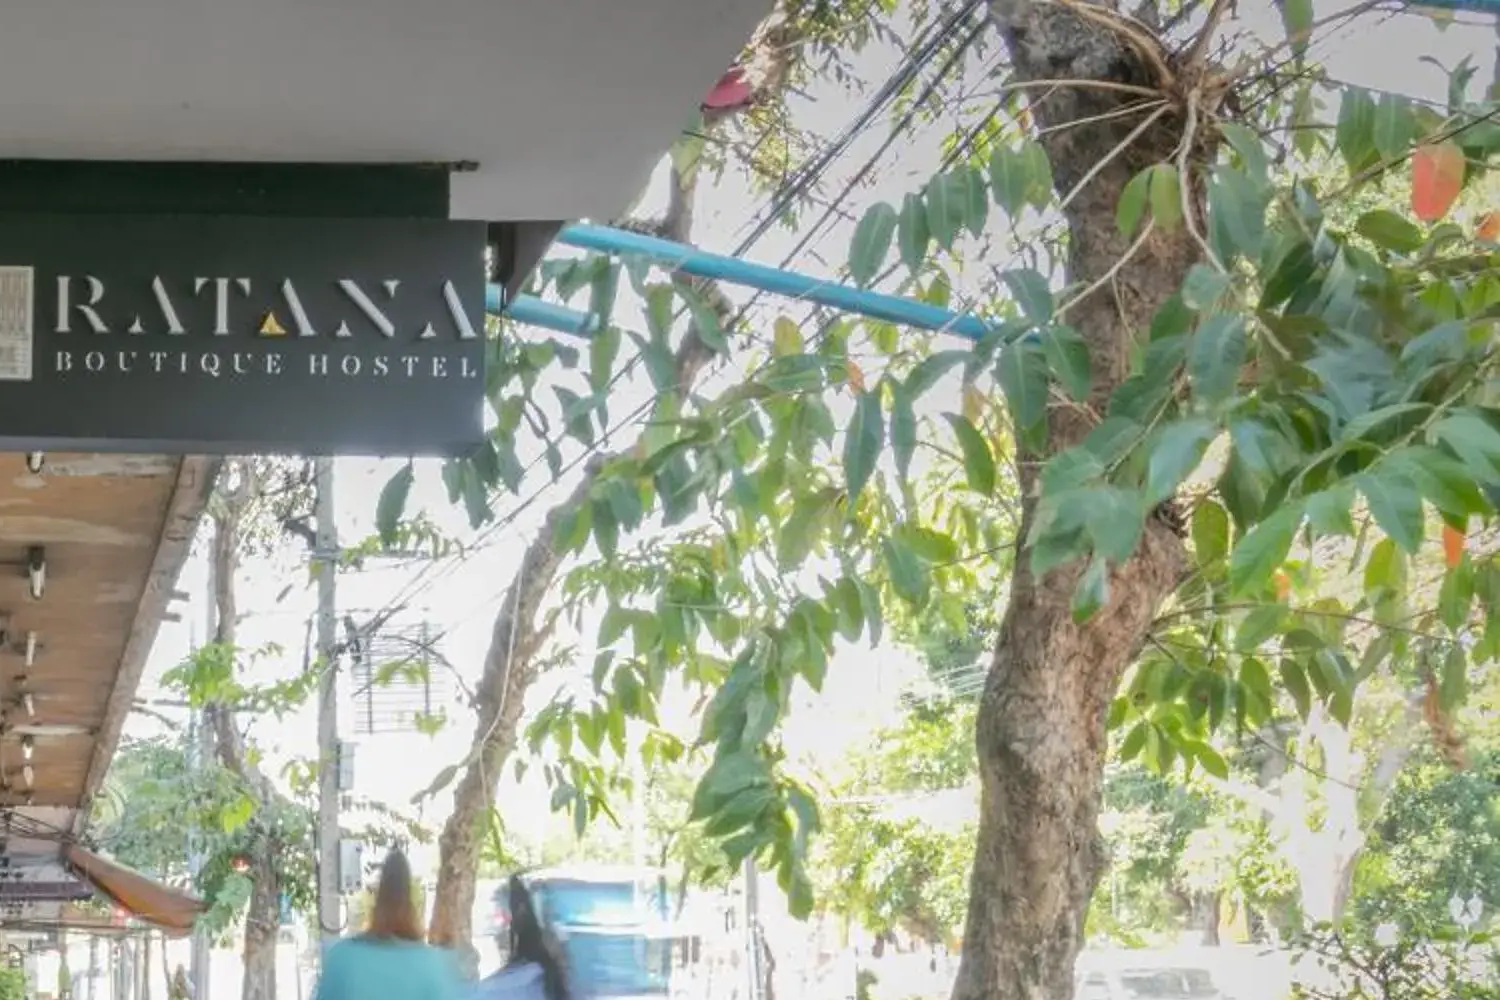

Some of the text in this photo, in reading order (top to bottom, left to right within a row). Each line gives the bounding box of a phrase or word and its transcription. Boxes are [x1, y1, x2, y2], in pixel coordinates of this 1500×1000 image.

[53, 274, 477, 340] RATANA
[55, 350, 477, 378] BOUTIQUE HOSTEL
